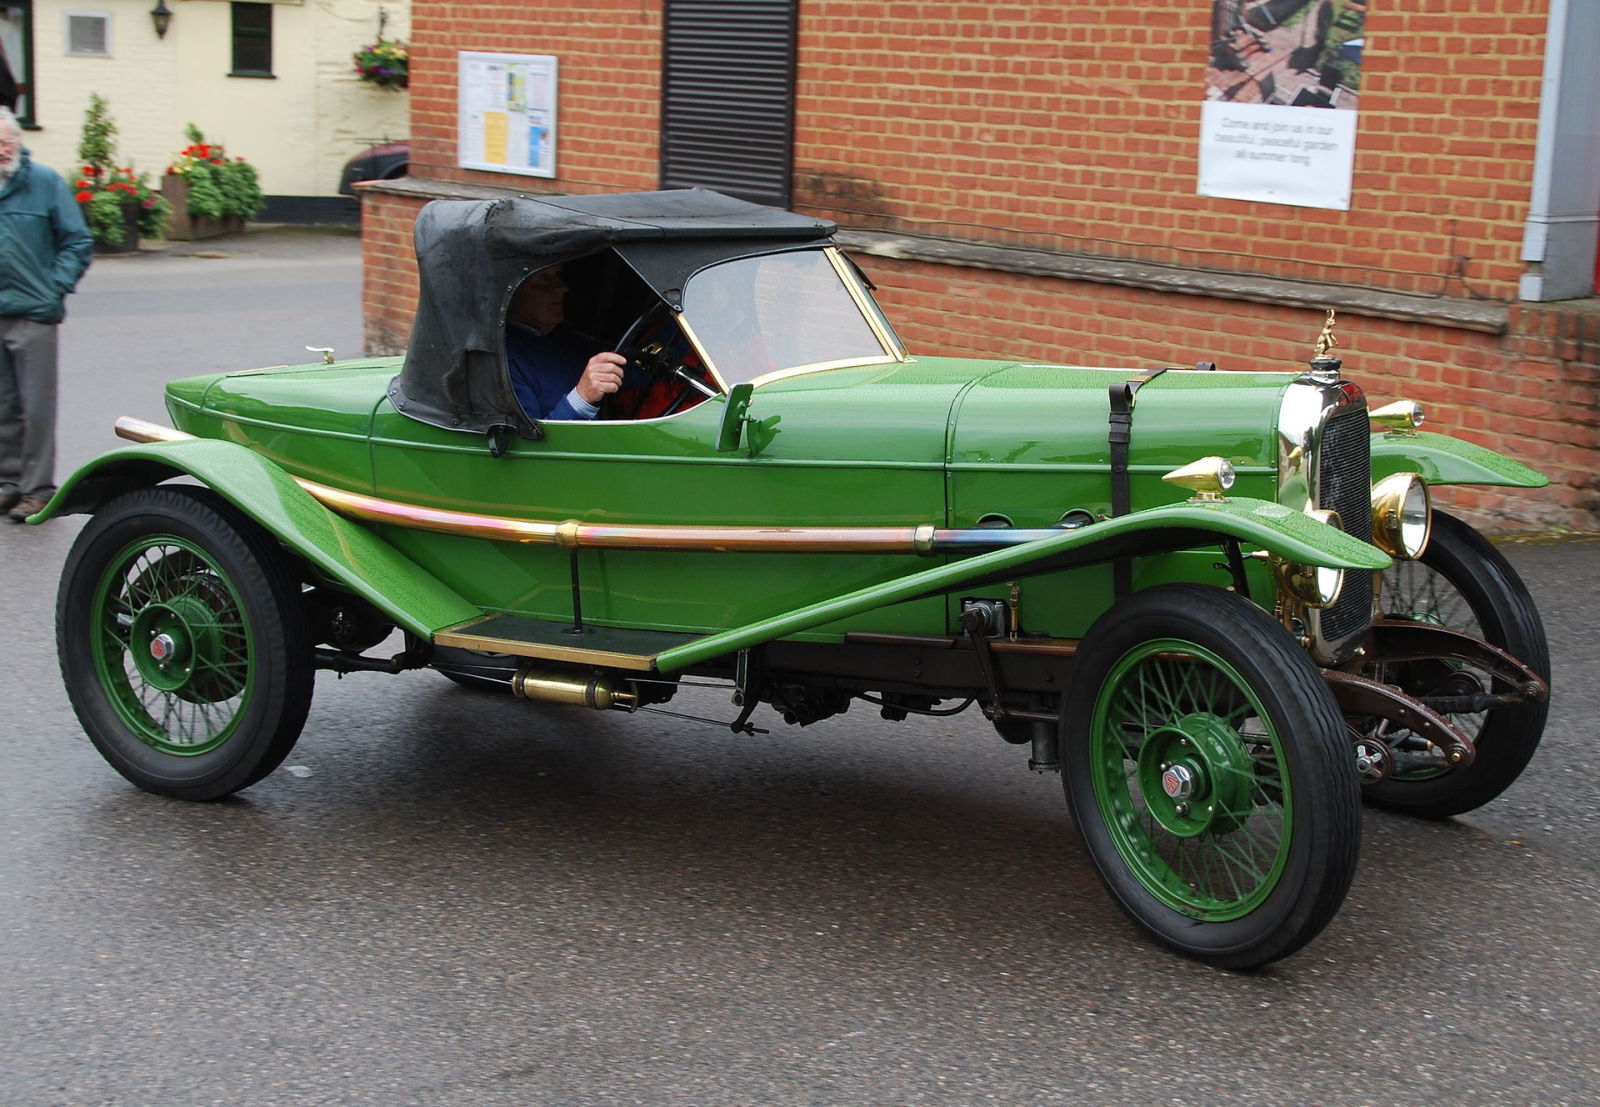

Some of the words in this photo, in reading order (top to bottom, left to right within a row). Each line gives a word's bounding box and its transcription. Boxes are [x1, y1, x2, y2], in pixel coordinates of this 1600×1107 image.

[1252, 120, 1271, 131] and
[1292, 124, 1304, 133] us
[1306, 125, 1315, 134] in
[1317, 126, 1335, 135] our
[1303, 140, 1338, 151] garden
[1235, 148, 1247, 159] all
[1248, 151, 1287, 162] summer
